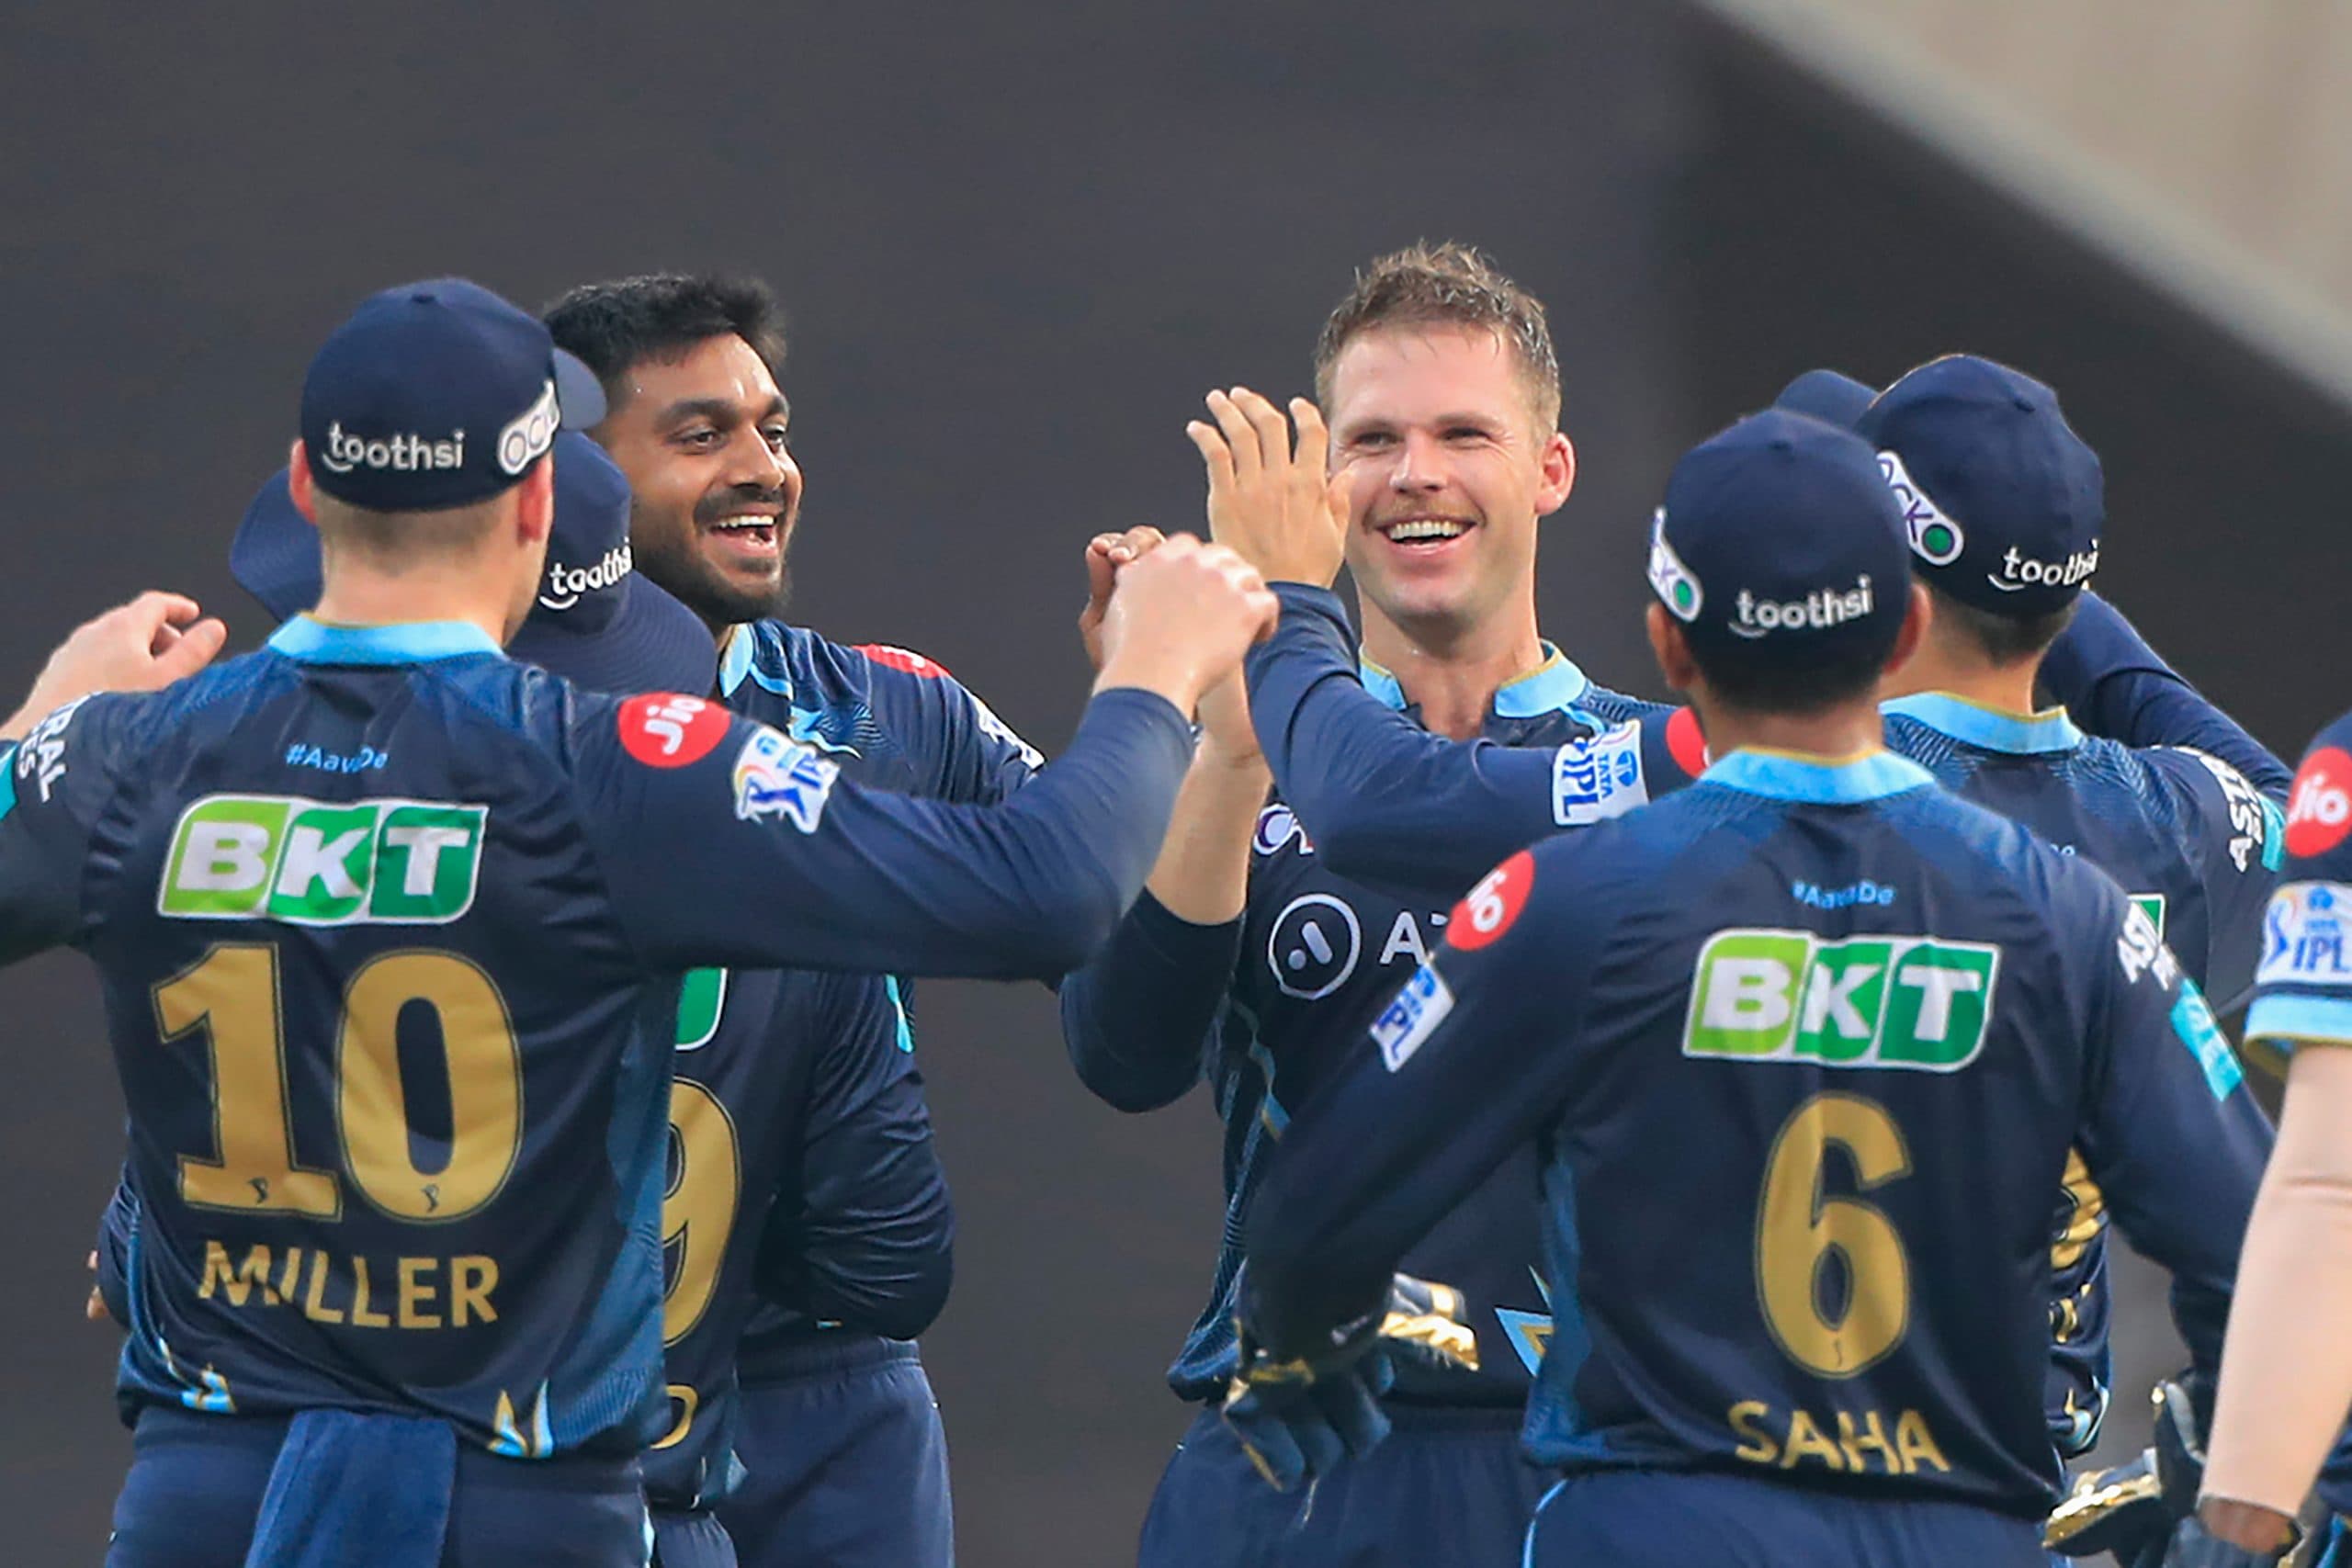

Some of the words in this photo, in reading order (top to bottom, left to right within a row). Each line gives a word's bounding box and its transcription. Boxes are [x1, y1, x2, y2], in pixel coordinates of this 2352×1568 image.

[324, 422, 466, 472] toothsi
[1733, 573, 1874, 632] toothsi
[644, 697, 707, 756] Jio
[1562, 752, 1600, 818] IPL
[175, 820, 472, 898] BKT
[2293, 935, 2350, 973] IPL
[1702, 957, 1983, 1043] BKT
[152, 942, 524, 1224] 10
[1755, 1090, 1914, 1380] 6
[198, 1240, 500, 1329] MILLER
[1727, 1400, 1951, 1473] SAHA
